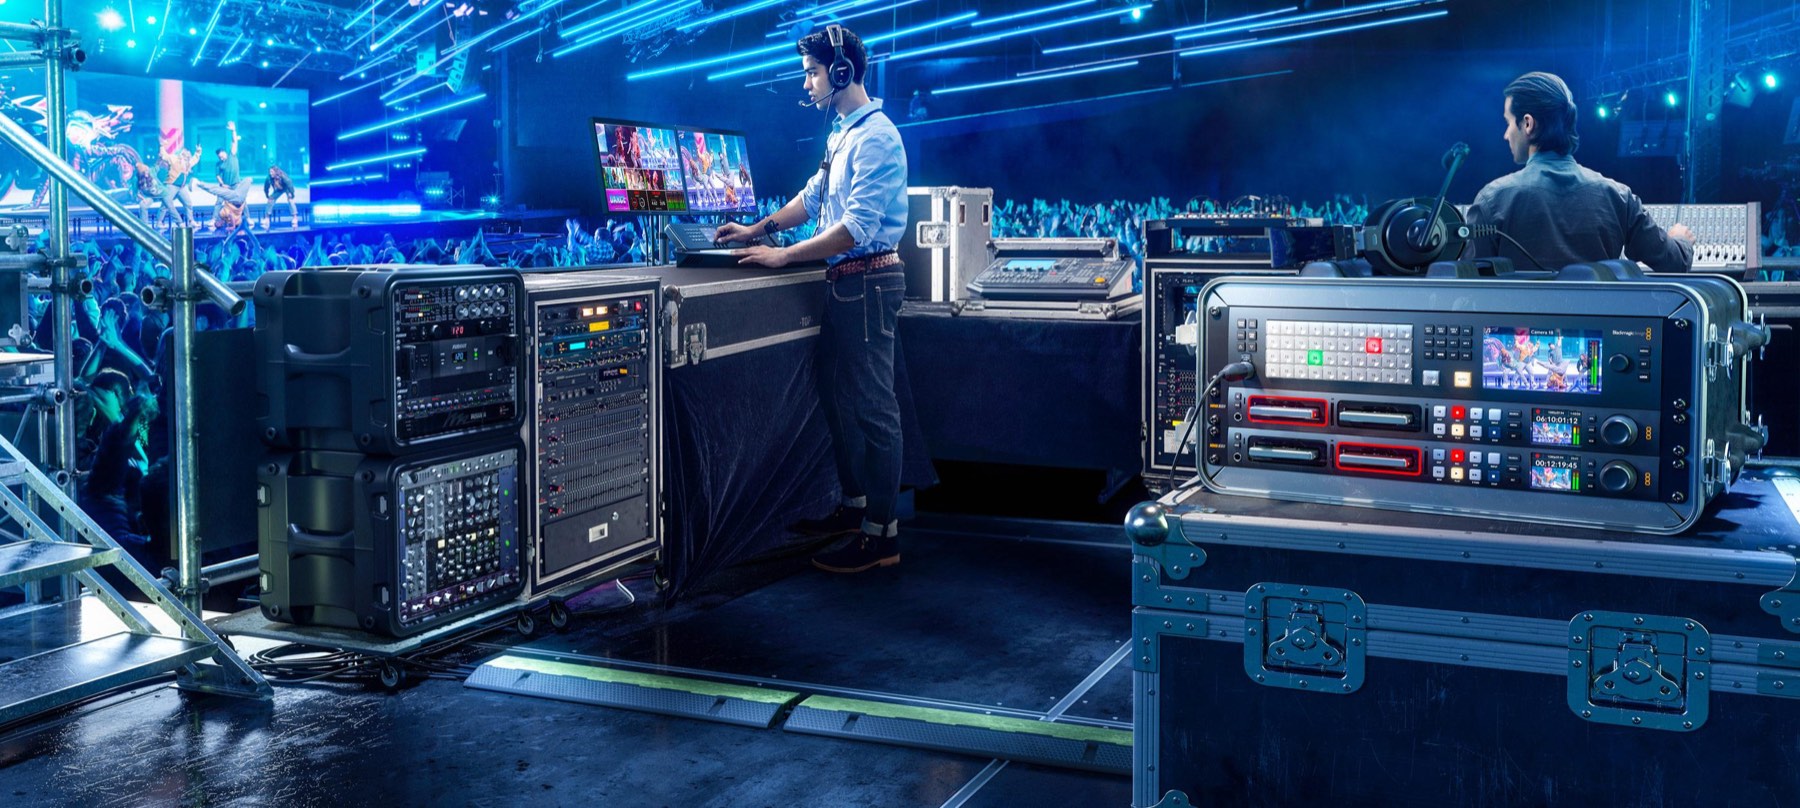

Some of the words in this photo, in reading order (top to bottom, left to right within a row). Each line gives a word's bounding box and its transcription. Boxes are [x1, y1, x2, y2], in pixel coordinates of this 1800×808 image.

[452, 326, 464, 335] 120
[1536, 415, 1578, 424] 06:10:01:12
[1535, 460, 1577, 469] 00:12:19:45
